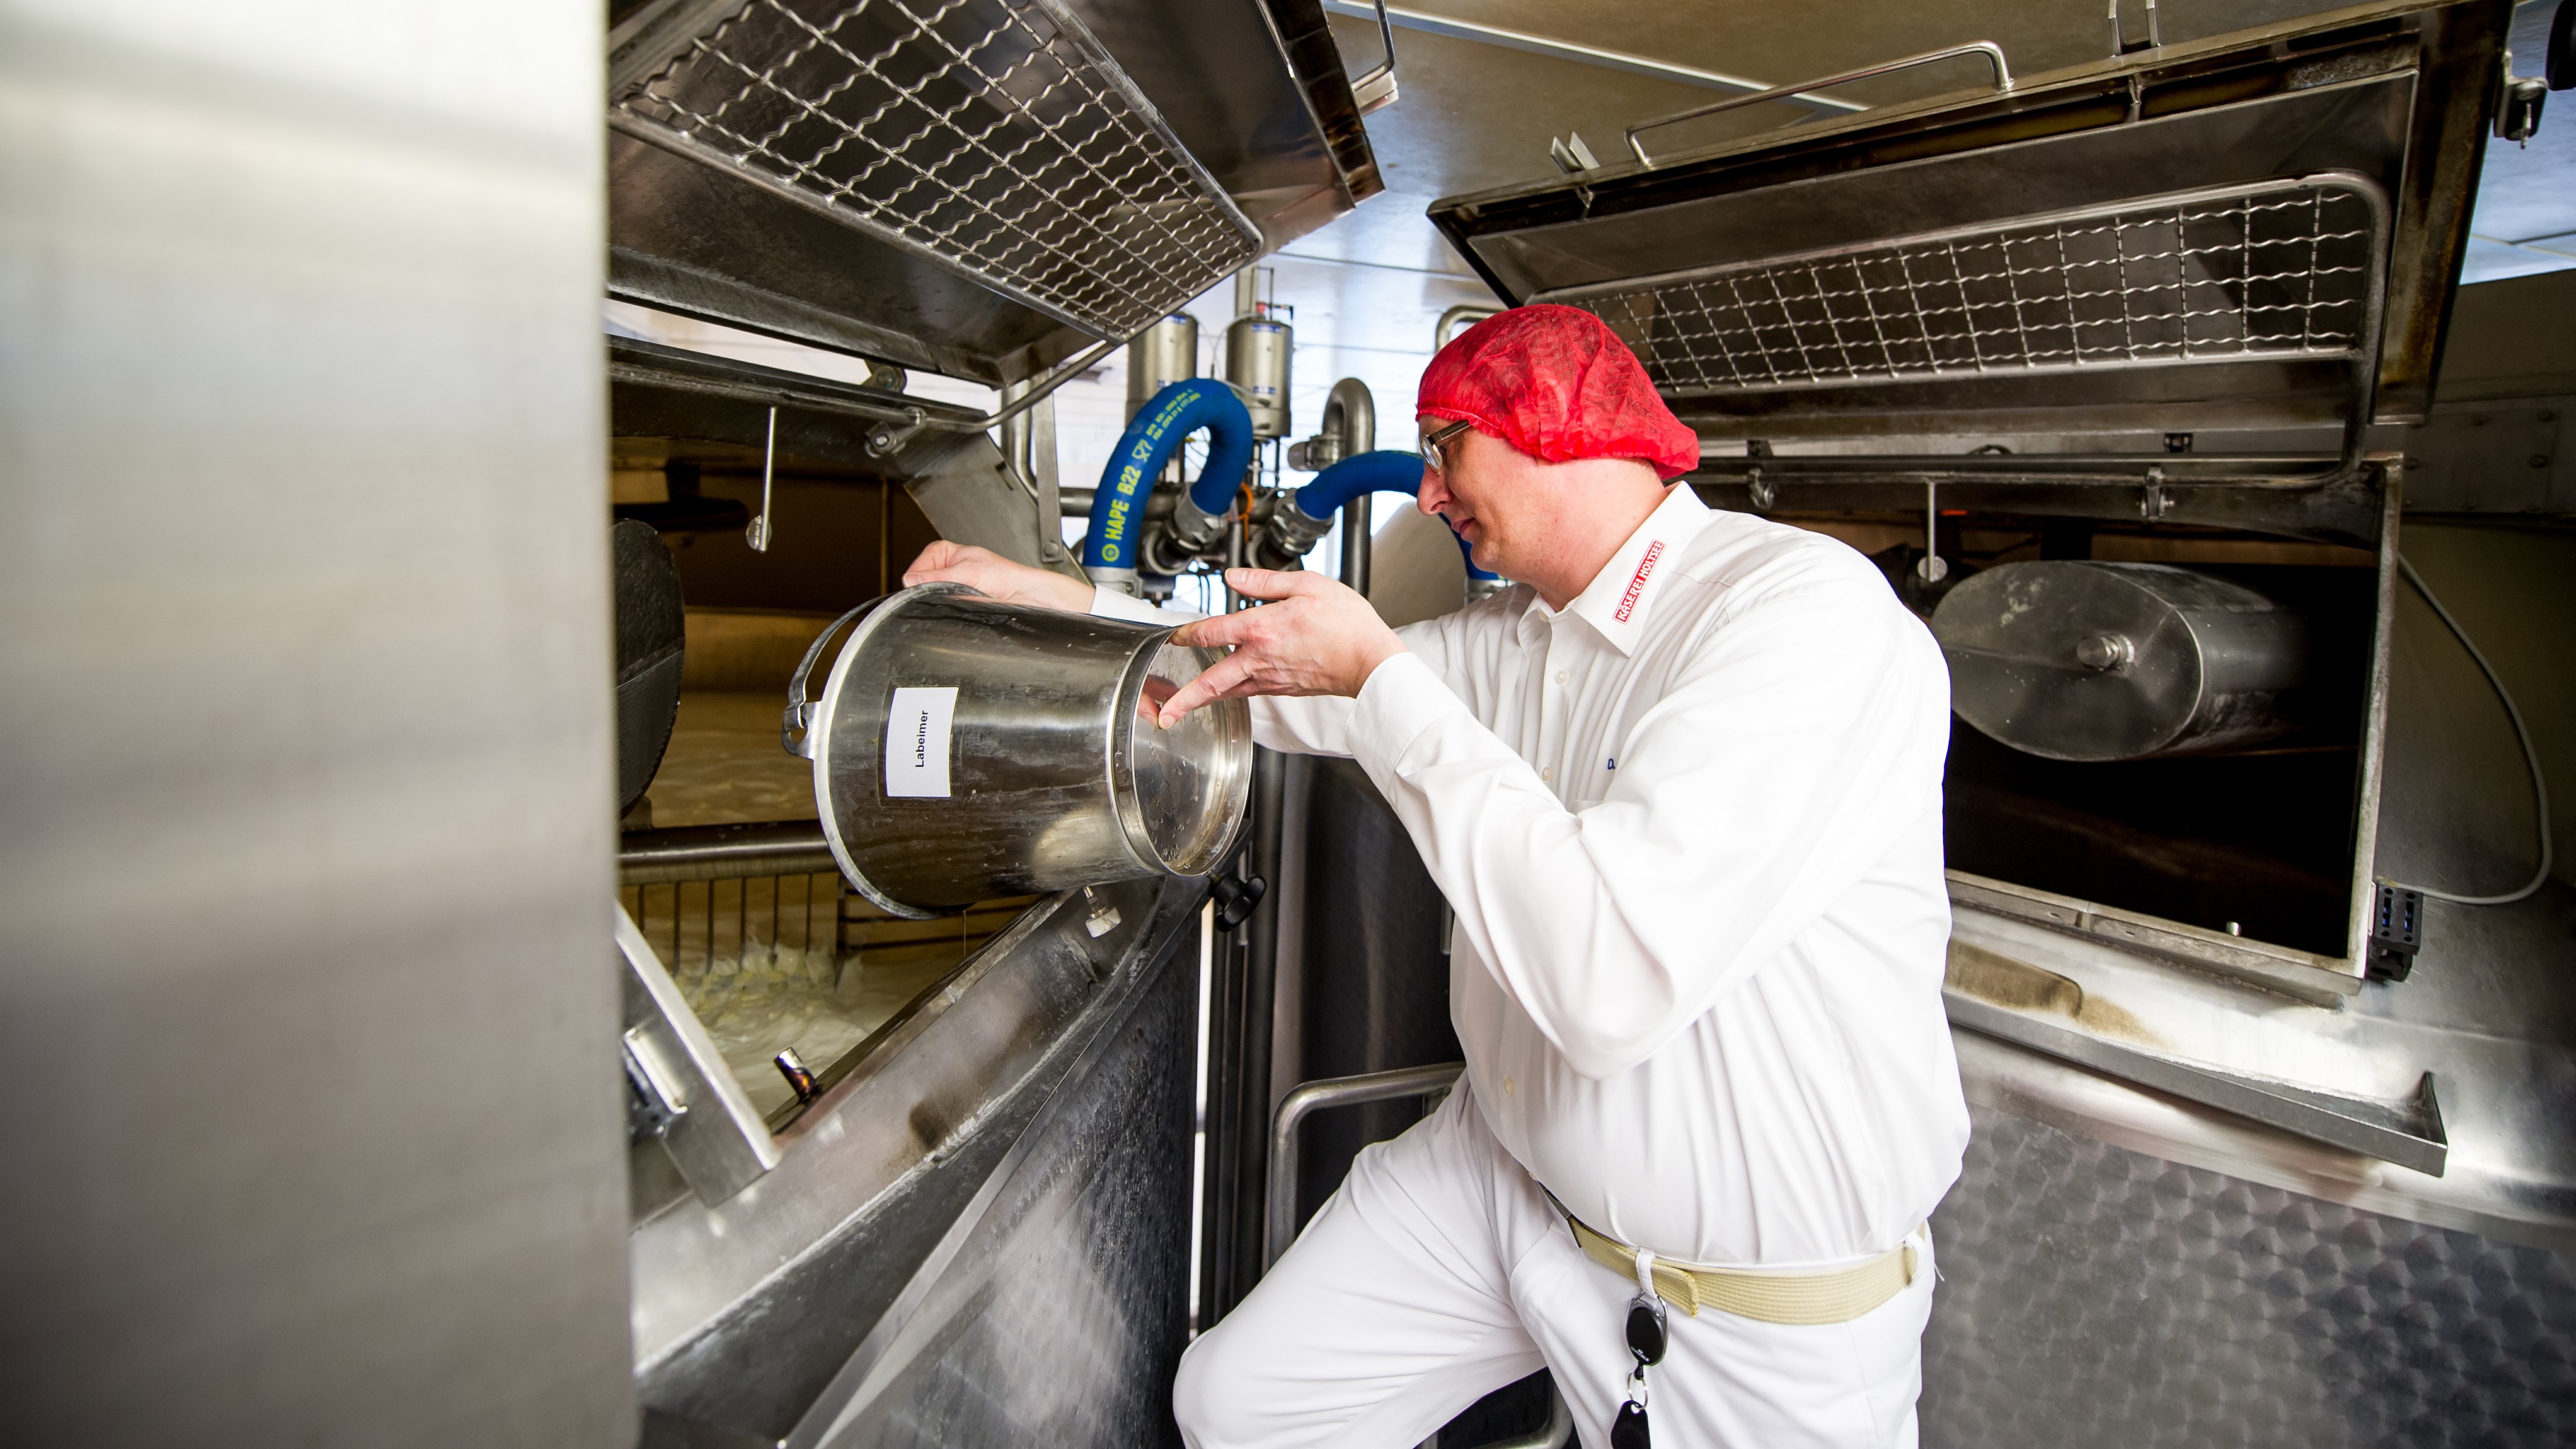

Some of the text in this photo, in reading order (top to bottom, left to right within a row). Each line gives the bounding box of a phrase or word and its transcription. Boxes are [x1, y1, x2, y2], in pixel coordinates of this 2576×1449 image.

[1105, 465, 1142, 540] HAPE B22
[1638, 540, 1664, 577] HOLTSEE
[915, 710, 928, 767] Labeimer
